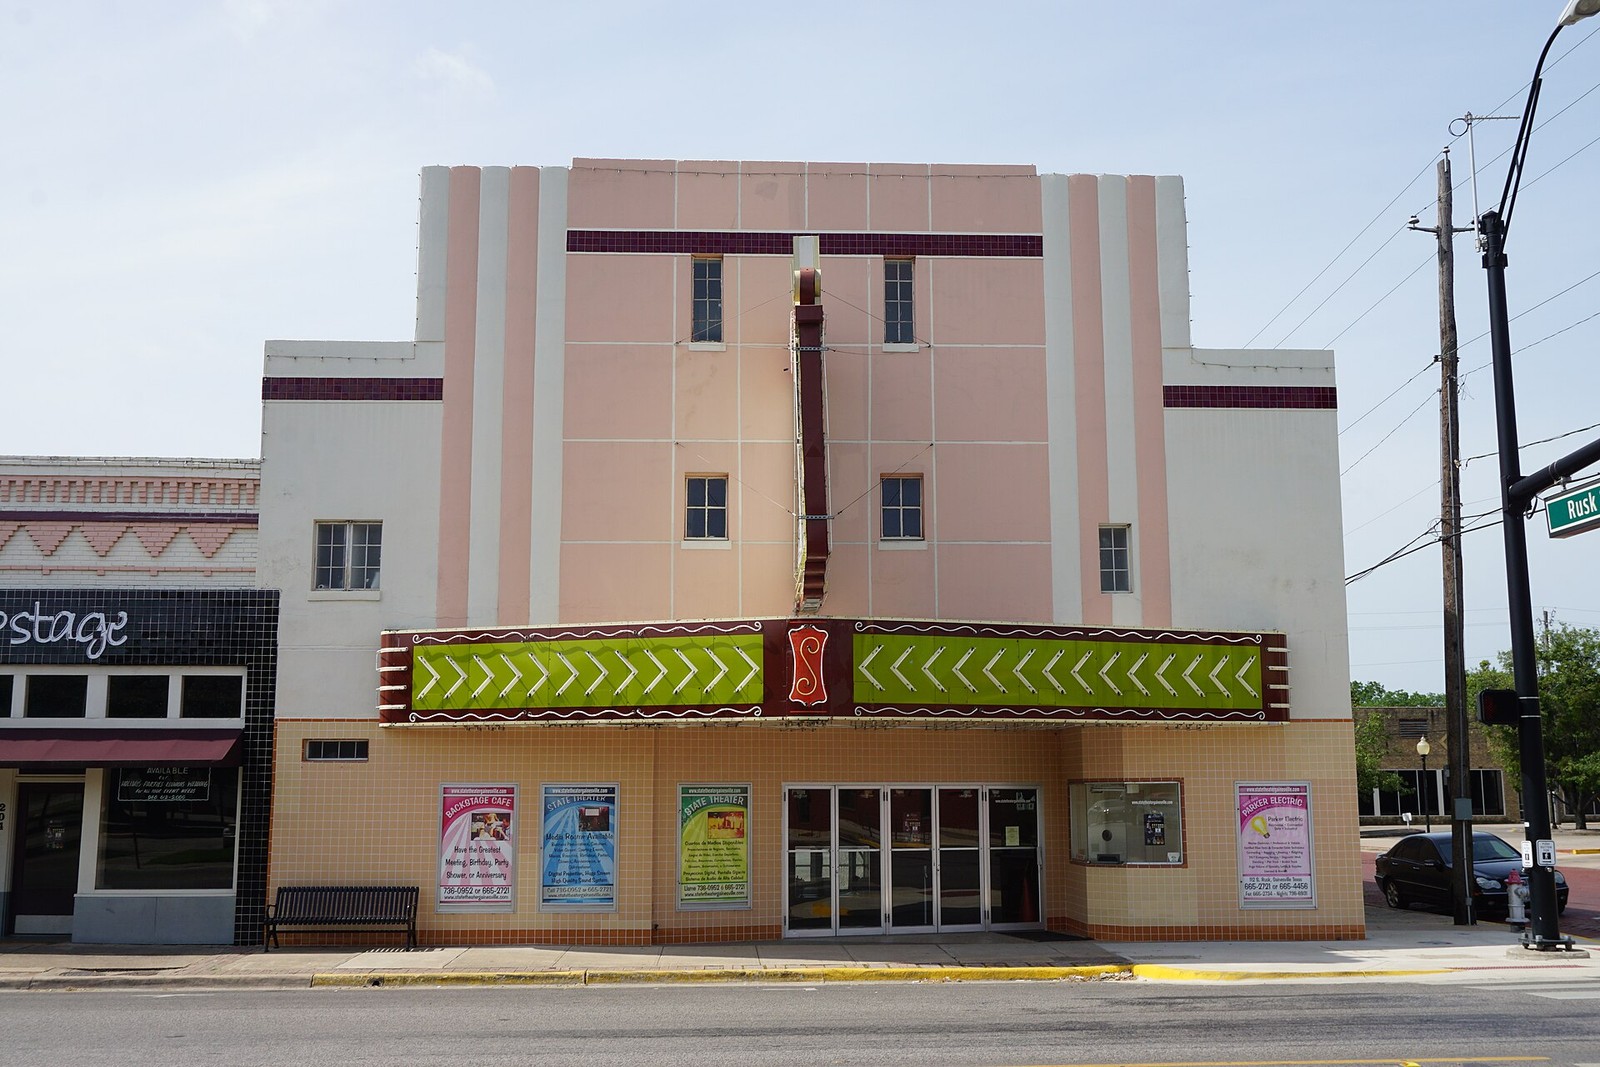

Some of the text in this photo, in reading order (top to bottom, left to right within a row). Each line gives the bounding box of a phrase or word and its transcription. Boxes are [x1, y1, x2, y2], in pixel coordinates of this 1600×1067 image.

[1567, 492, 1597, 519] Rusk
[445, 797, 512, 819] BACKSTAGE CAFE
[547, 796, 571, 812] STATE
[684, 796, 744, 816] STATE THEATER
[1242, 796, 1303, 817] PARKER ELECTRIC
[454, 846, 501, 854] Have the Greatest
[494, 858, 509, 868] Party
[446, 871, 468, 880] Shower,
[475, 871, 507, 881] Anniversary
[443, 886, 474, 894] 736-0952
[482, 886, 510, 894] 665-2721
[1244, 882, 1270, 890] 665-2721
[1279, 882, 1308, 890] 665-4456
